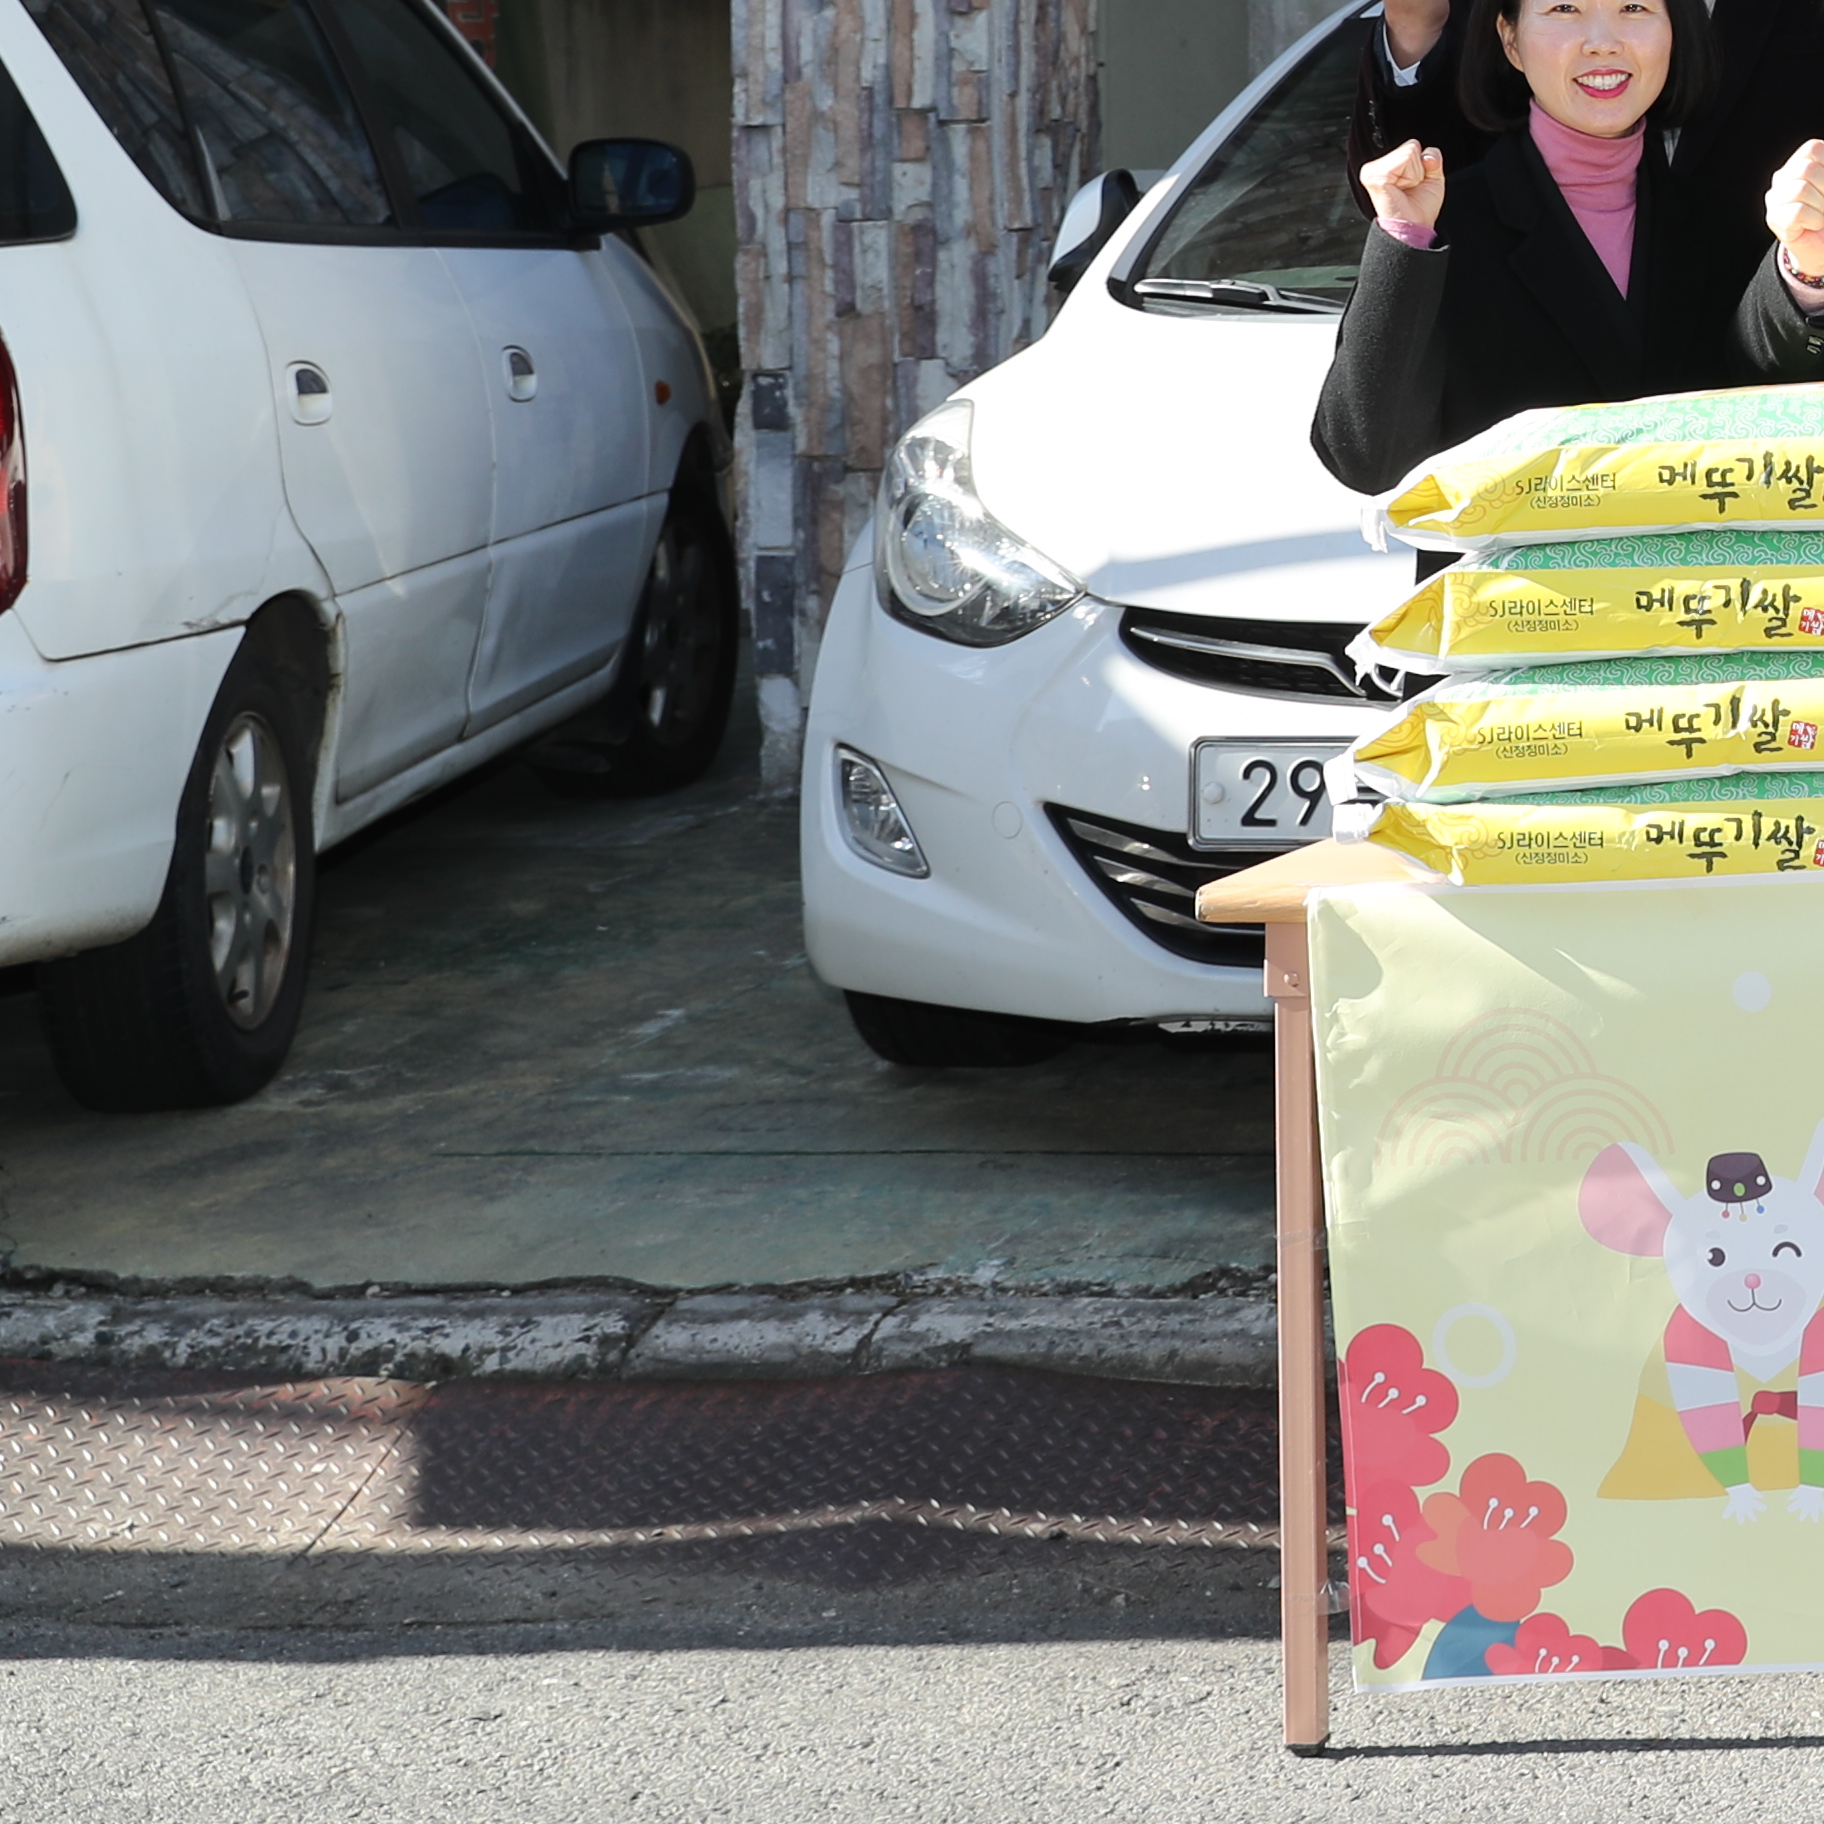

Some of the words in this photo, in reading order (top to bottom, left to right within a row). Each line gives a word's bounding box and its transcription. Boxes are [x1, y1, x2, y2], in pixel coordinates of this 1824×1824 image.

[1516, 472, 1616, 497] SJ라이스센터
[1658, 451, 1824, 514] 메뚜기쌀
[1488, 597, 1594, 619] SJ라이스센터
[1636, 578, 1801, 639] 메뚜기쌀
[1478, 720, 1583, 744] SJ라이스센터
[1625, 696, 1791, 759] 메뚜기쌀
[1242, 759, 1325, 827] 29
[1497, 830, 1604, 850] SJ라이스센터
[1646, 810, 1815, 872] 메뚜기쌀
